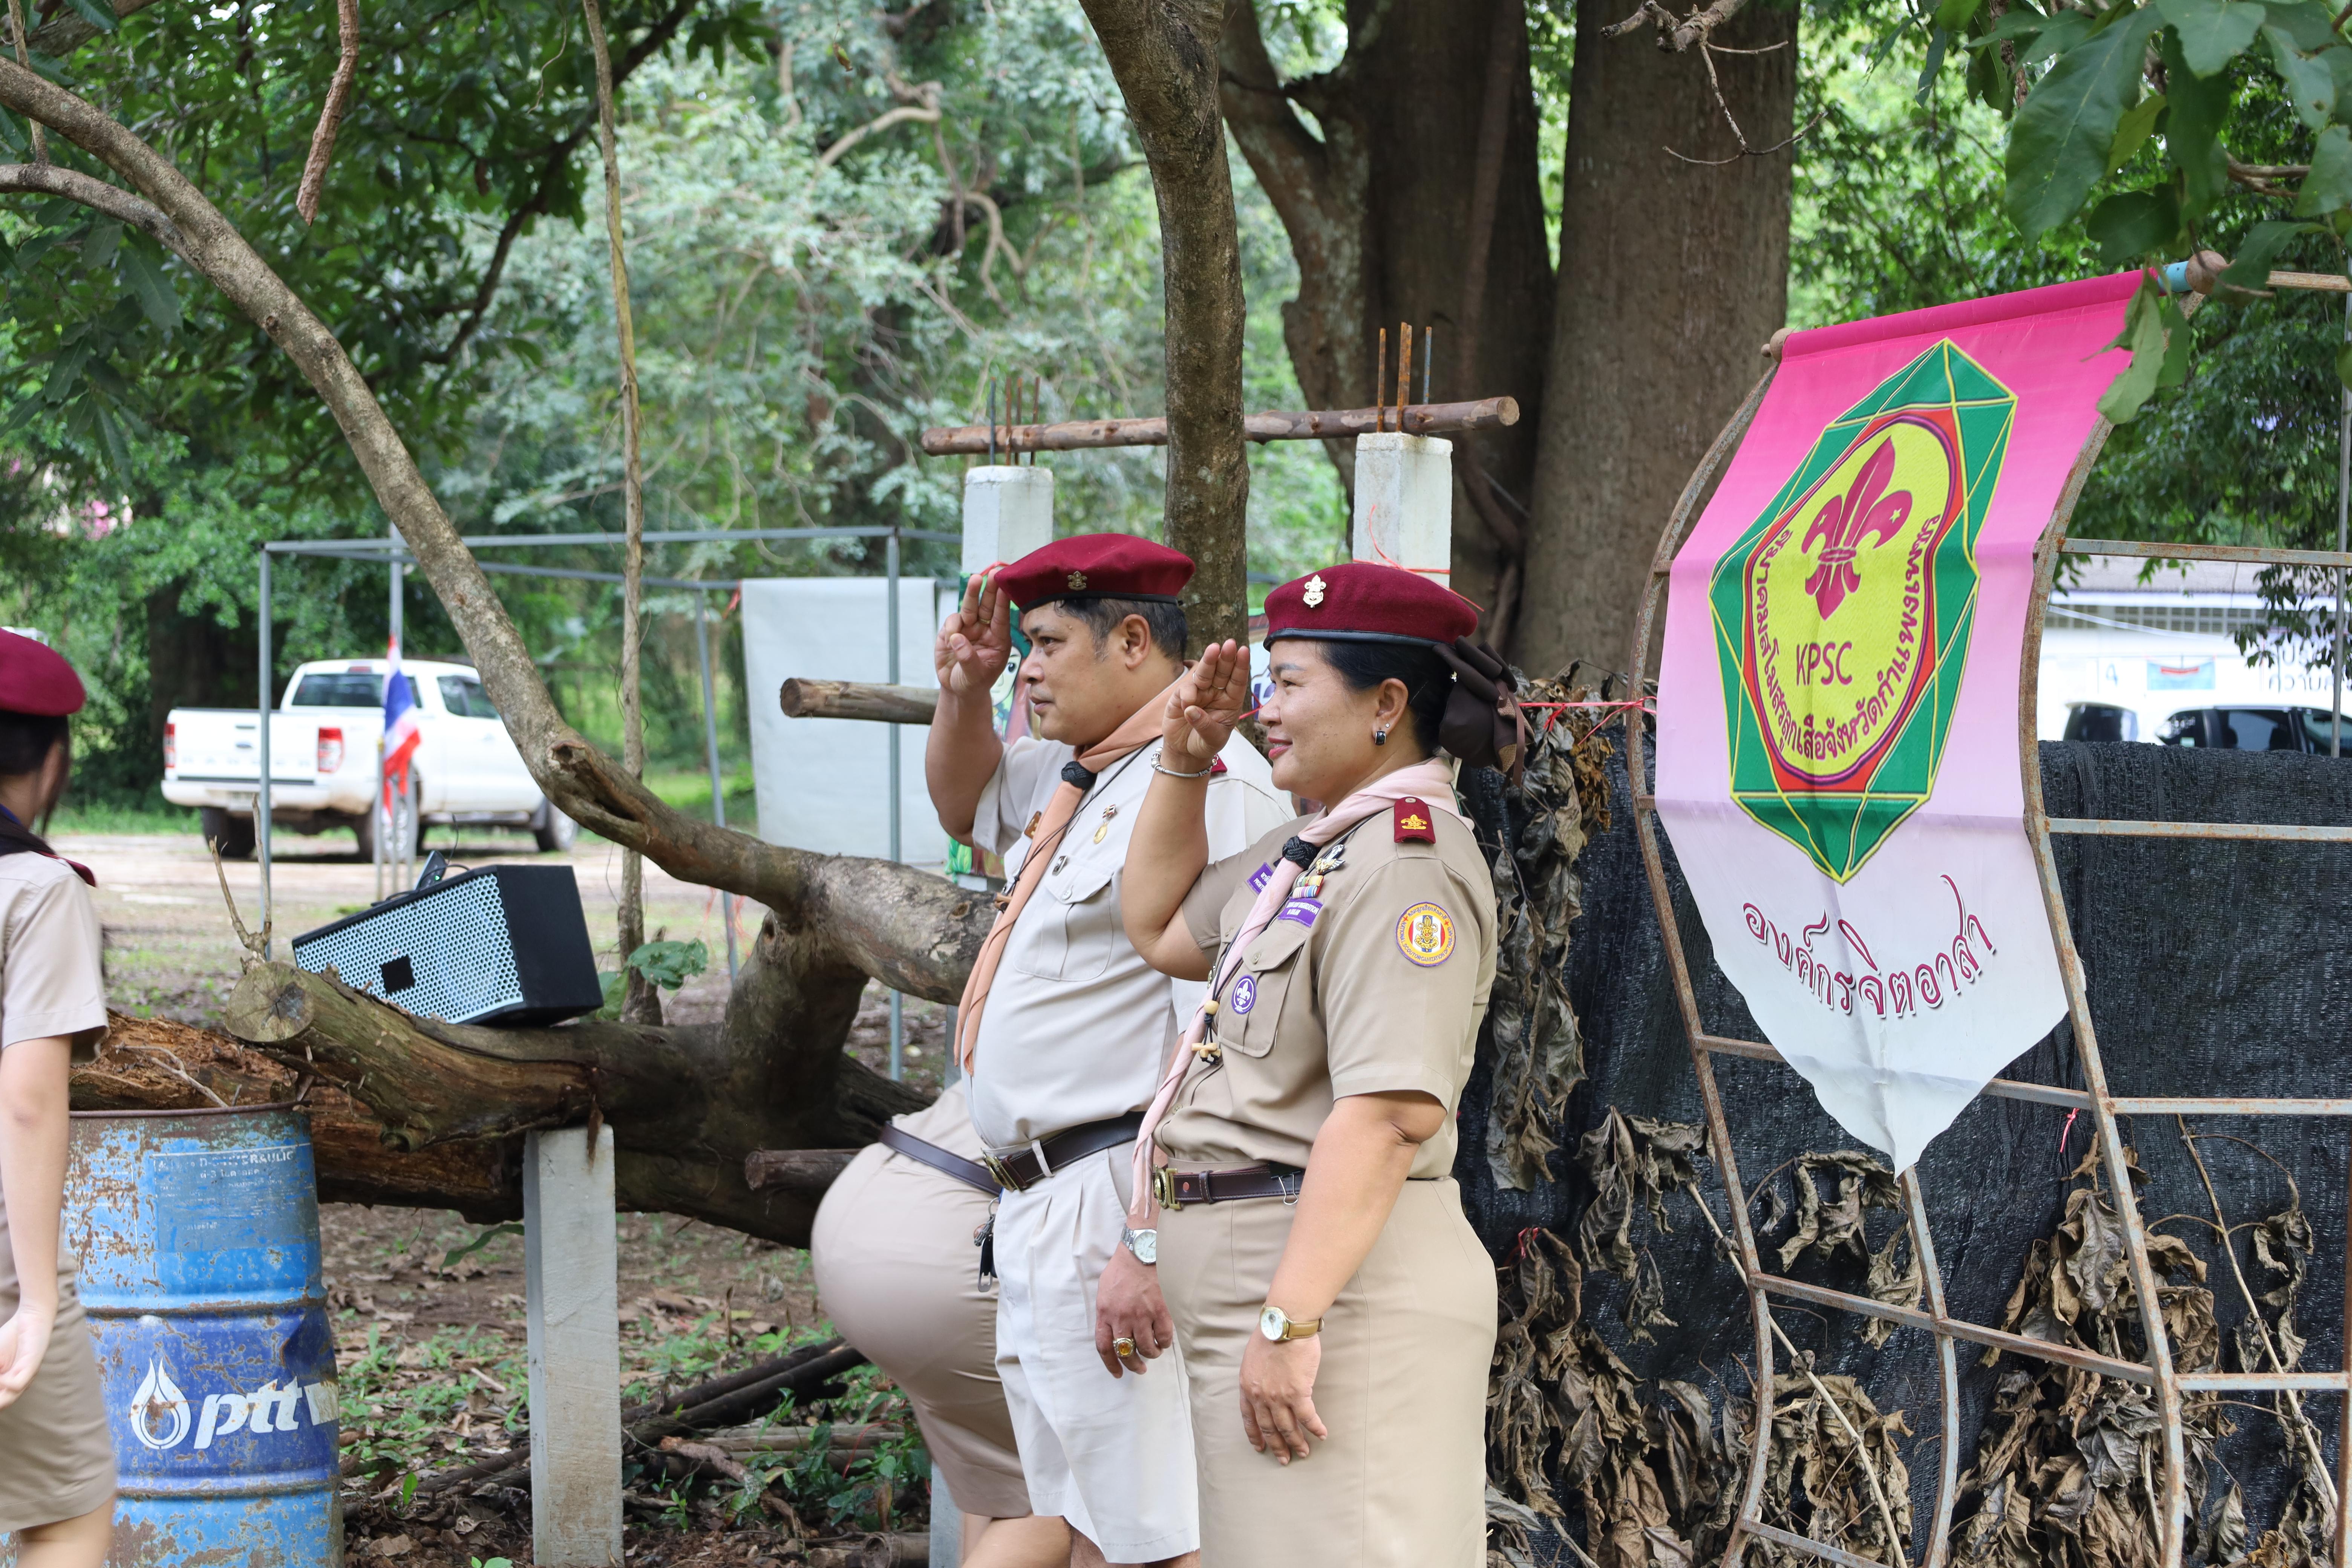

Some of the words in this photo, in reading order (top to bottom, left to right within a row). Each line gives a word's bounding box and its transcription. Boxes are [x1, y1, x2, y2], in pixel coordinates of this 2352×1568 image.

[1796, 642, 1853, 686] KPSC
[1403, 943, 1416, 957] SCOUT
[1414, 952, 1446, 962] ORGANIZATION
[1742, 873, 1994, 1017] องค์กรจิตอาสา
[194, 1377, 304, 1449] ptt
